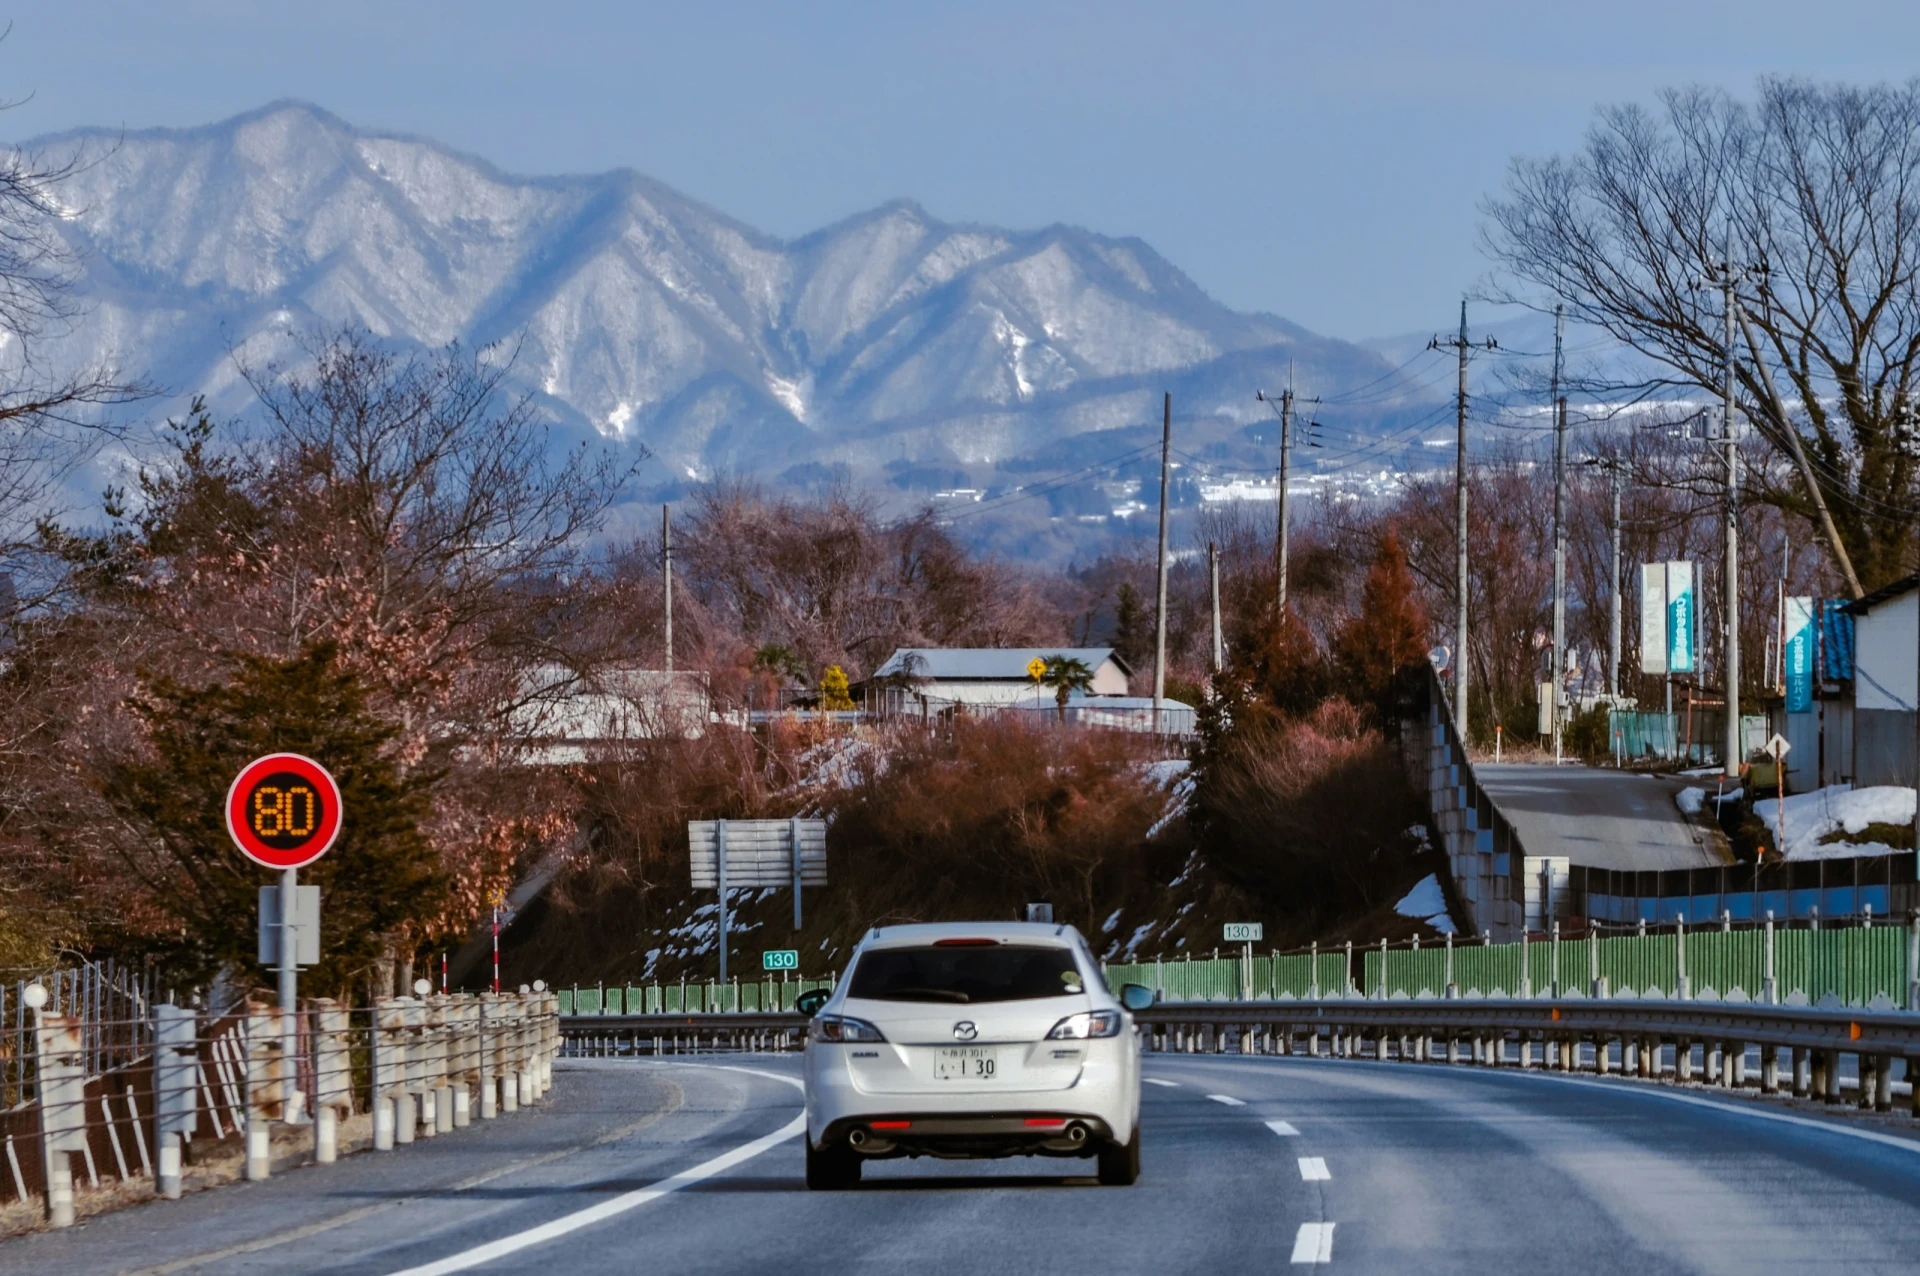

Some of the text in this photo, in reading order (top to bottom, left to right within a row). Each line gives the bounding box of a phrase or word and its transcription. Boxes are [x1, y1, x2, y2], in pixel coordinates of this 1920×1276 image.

[254, 787, 314, 836] 80
[1226, 925, 1250, 938] 130
[767, 953, 794, 967] 130
